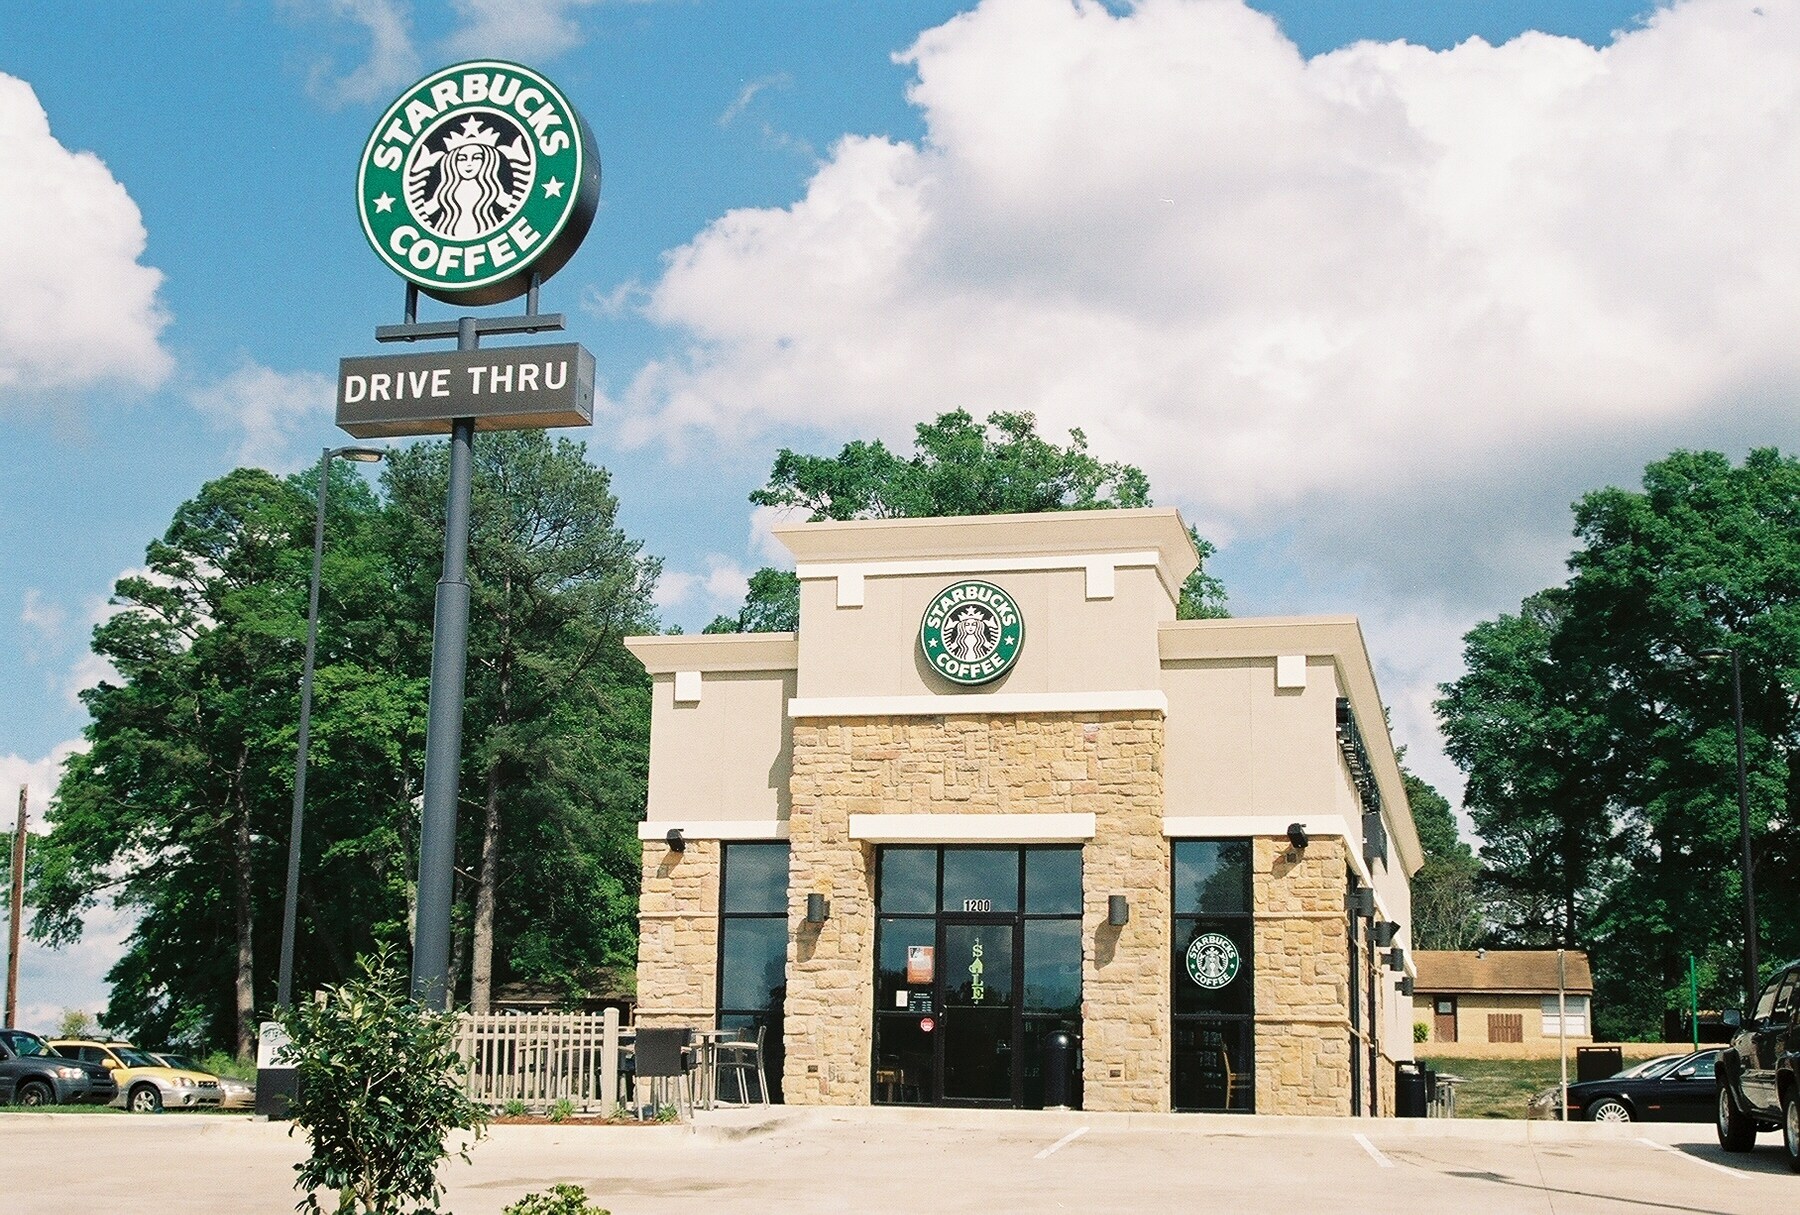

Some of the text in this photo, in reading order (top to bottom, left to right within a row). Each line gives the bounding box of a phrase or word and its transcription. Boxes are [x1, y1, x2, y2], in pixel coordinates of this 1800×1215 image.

[373, 73, 569, 172] STARBUCKS
[389, 216, 541, 277] COFFEE
[344, 361, 568, 403] DRIVE THRU
[927, 586, 1016, 629] STARBUCKS
[936, 654, 1005, 678] COFFEE
[965, 900, 990, 911] 1200
[1189, 935, 1236, 960] STARBUCKS
[1194, 972, 1231, 986] COFFEE
